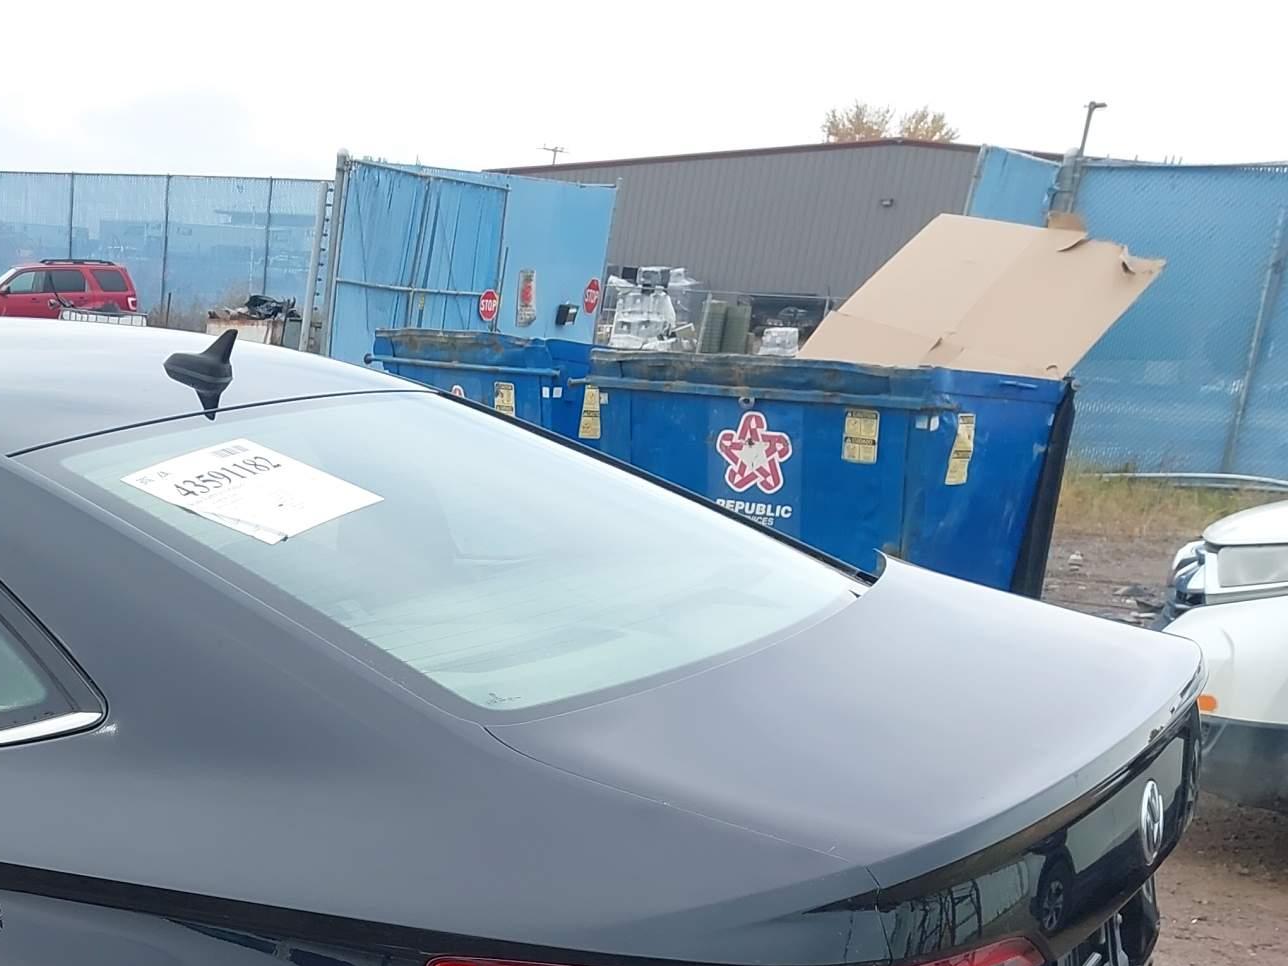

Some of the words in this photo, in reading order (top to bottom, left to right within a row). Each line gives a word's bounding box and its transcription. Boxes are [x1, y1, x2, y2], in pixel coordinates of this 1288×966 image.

[585, 289, 599, 303] STOP
[480, 299, 496, 311] STOP
[174, 456, 281, 497] 43591182
